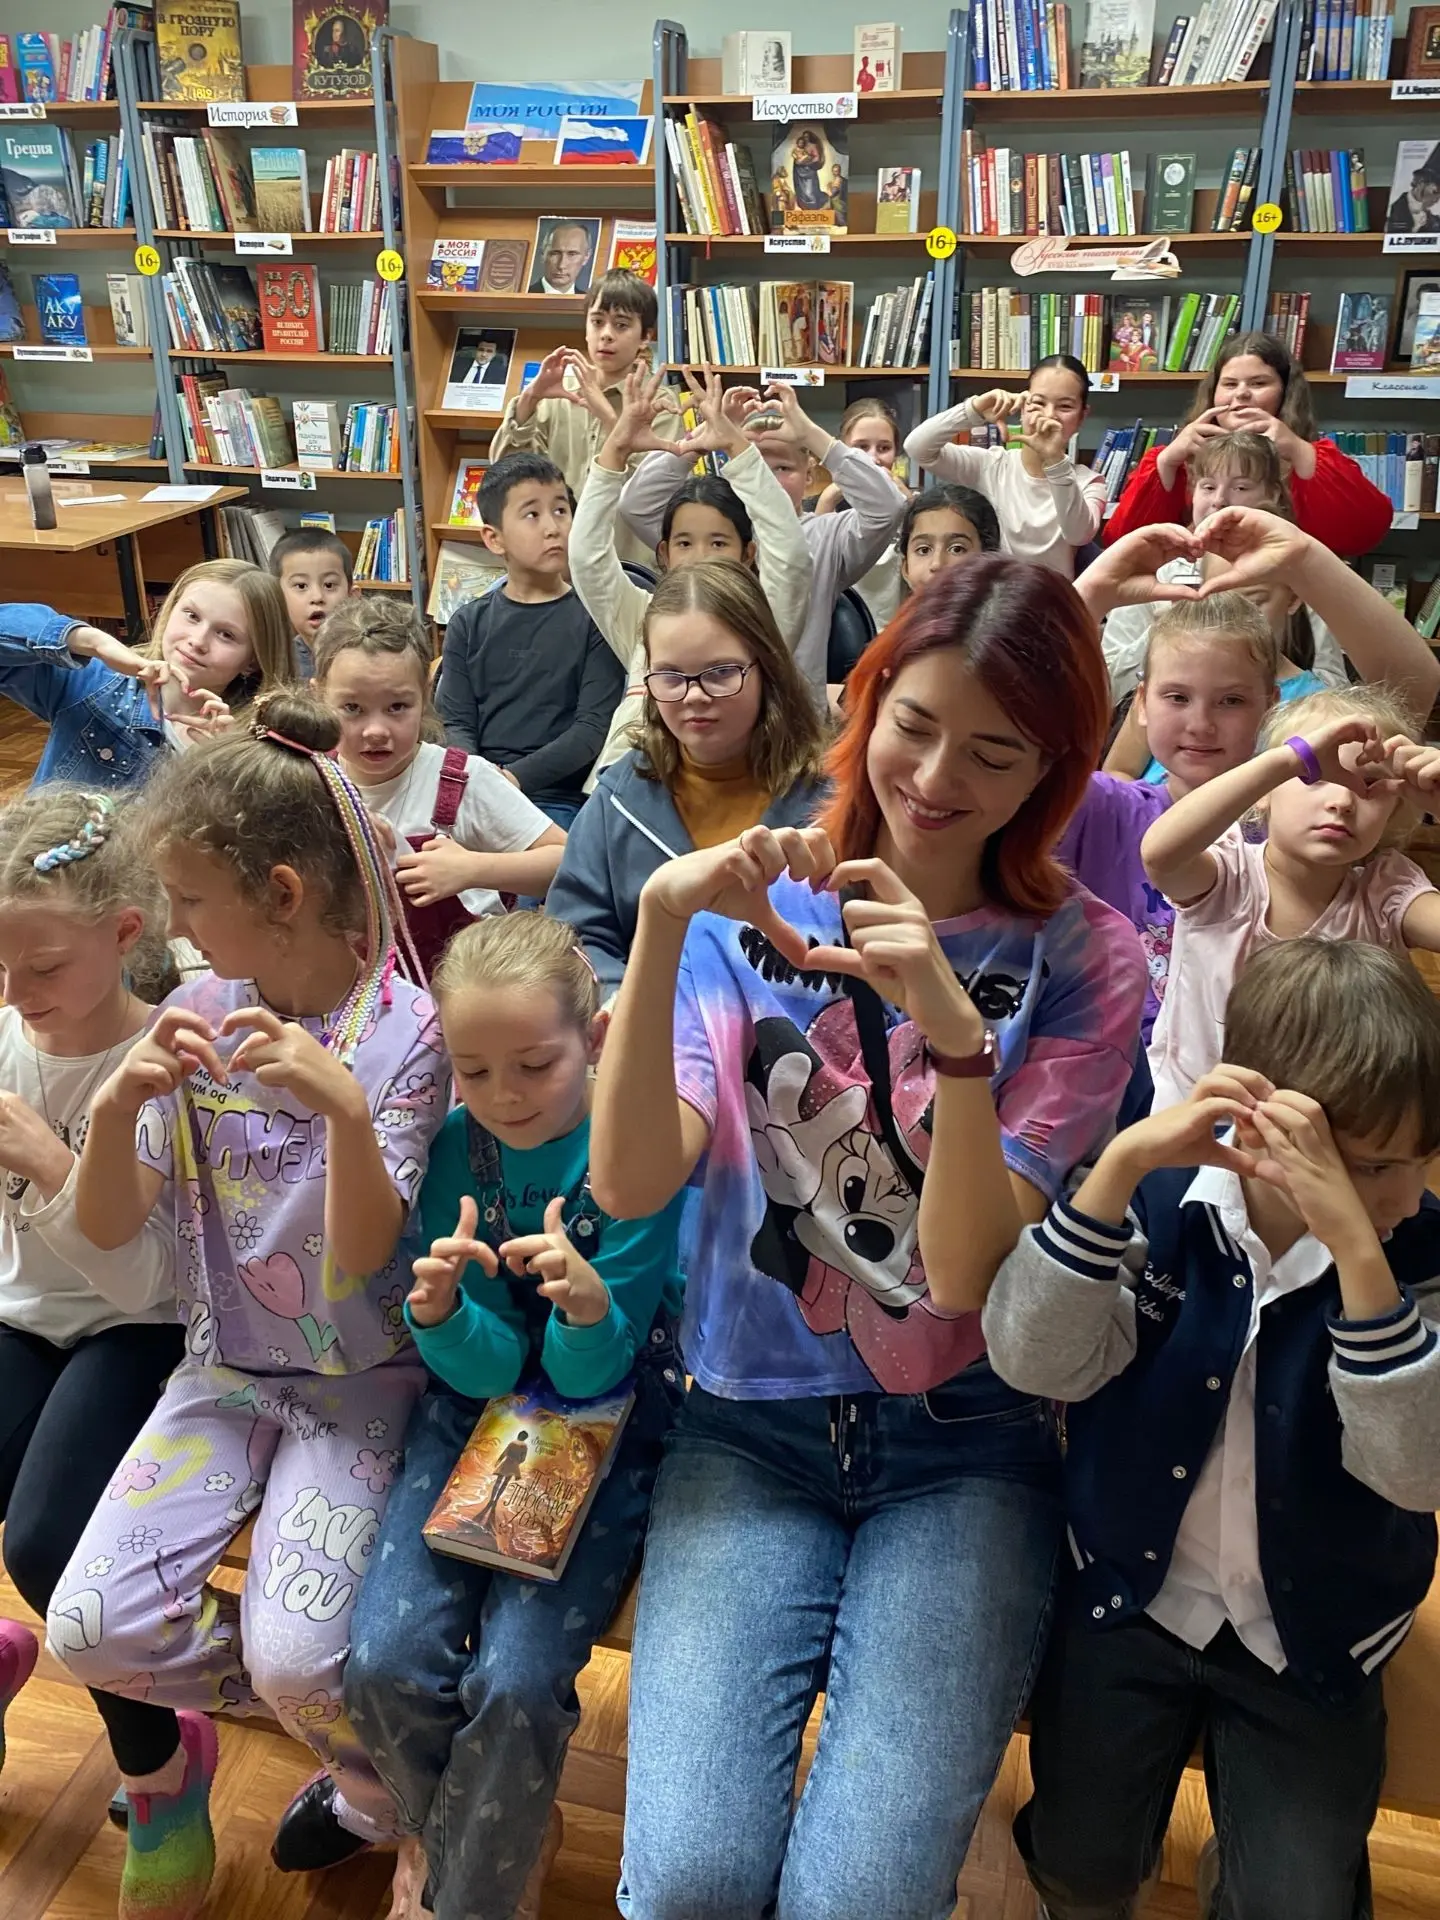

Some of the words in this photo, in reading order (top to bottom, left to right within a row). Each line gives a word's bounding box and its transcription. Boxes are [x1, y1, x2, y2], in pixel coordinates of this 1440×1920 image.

[158, 14, 166, 24] В
[170, 14, 236, 28] ГРОЗНУЮ
[180, 25, 215, 37] ПОРУ
[314, 74, 366, 86] КУТУЗОВ
[210, 106, 268, 126] История
[473, 103, 519, 118] МОЯ
[525, 102, 608, 118] РОССИЯ
[755, 100, 834, 120] Искусство
[5, 138, 54, 159] Греция
[785, 212, 829, 225] Рафаэль
[1256, 212, 1279, 224] 16+
[239, 239, 265, 249] История
[447, 241, 470, 249] МОЯ
[769, 237, 806, 247] Искусство
[928, 234, 957, 249] 16+
[139, 252, 160, 267] 16+
[437, 249, 477, 257] РОССИЯ
[1014, 237, 1078, 273] Русские
[380, 257, 402, 273] 16+
[263, 270, 312, 318] 50
[45, 298, 76, 314] АКУ
[47, 315, 78, 330] АКУ
[765, 371, 798, 380] Живопись
[1372, 382, 1429, 391] Классика
[1137, 1294, 1165, 1322] ibes
[263, 1542, 353, 1622] YOU
